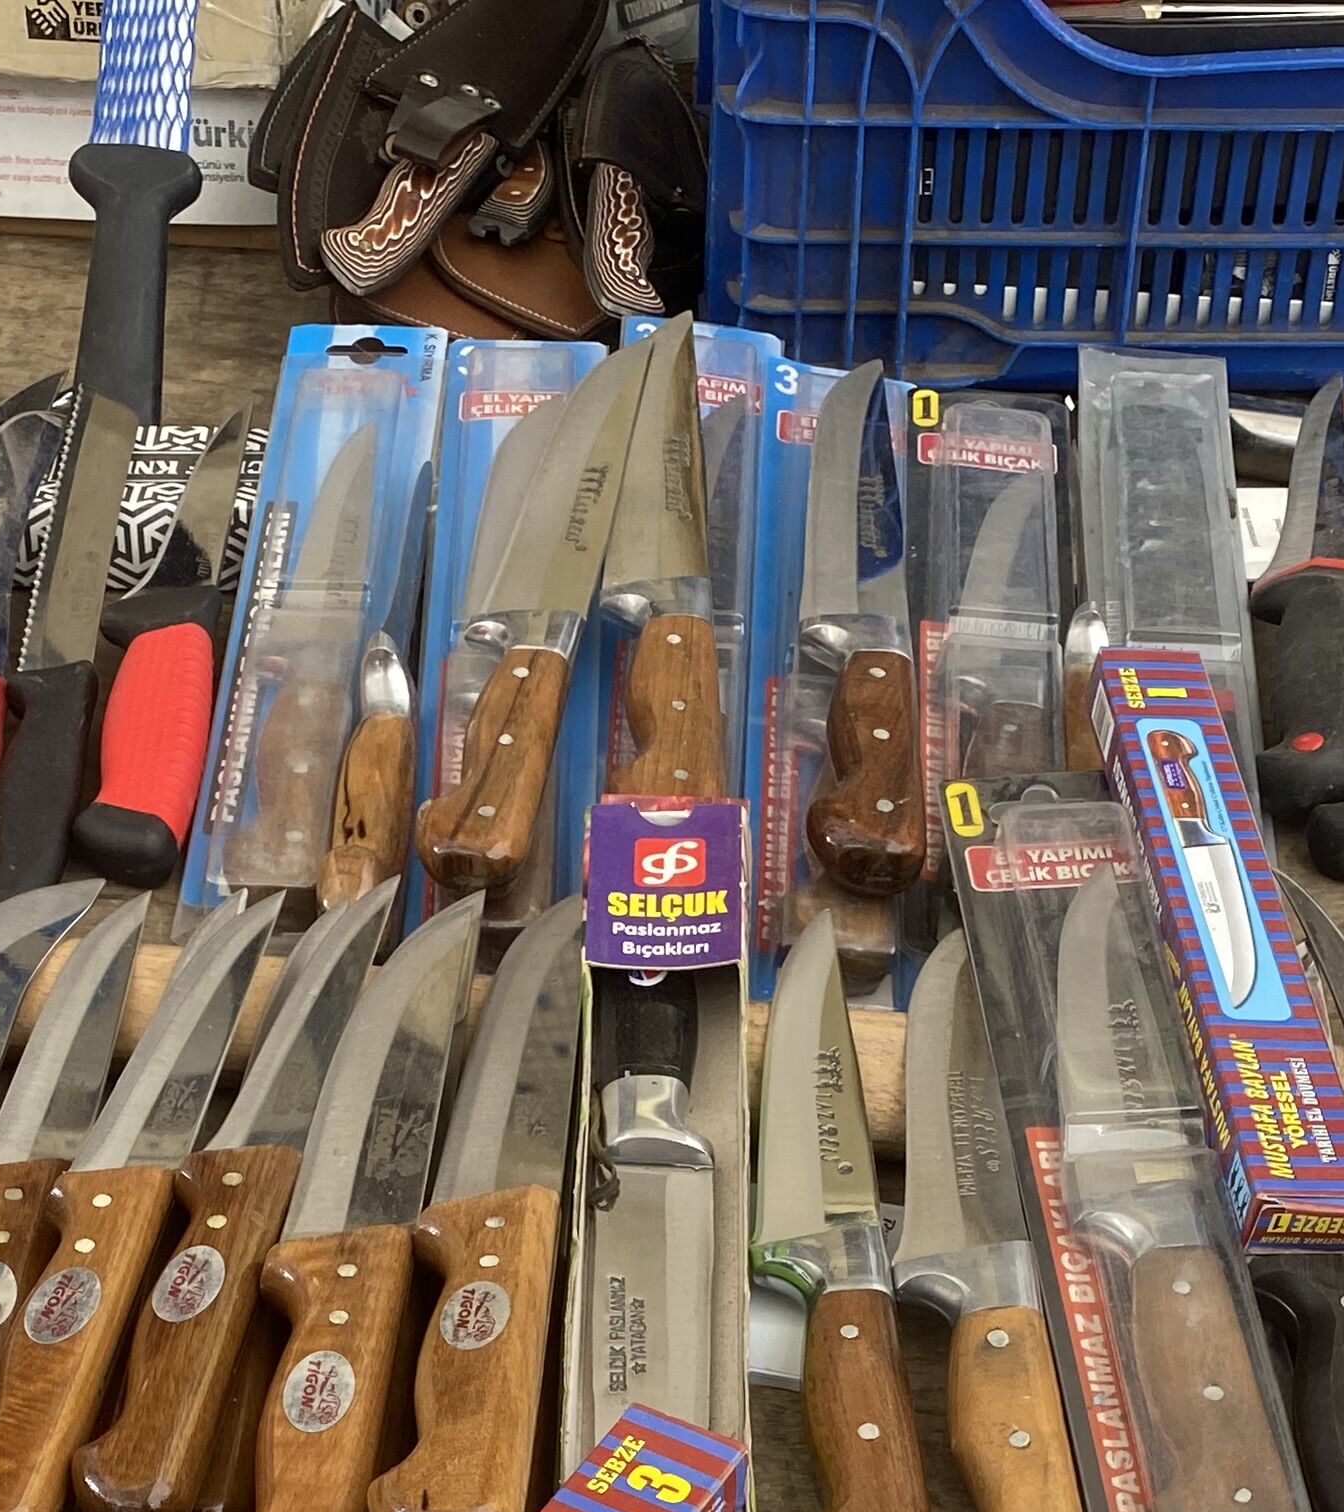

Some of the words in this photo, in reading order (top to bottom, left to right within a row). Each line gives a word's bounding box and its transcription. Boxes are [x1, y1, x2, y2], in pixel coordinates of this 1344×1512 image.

[774, 364, 801, 395] 3
[1057, 860, 1131, 884] BIÇK
[607, 890, 729, 922] SELÇUK
[612, 922, 722, 938] Paslanmaz
[622, 941, 710, 959] Bıçakları
[1230, 1038, 1271, 1101] BAYLAN
[1270, 1070, 1308, 1150] YÖRESEL
[1305, 1106, 1325, 1123] EL
[1250, 1103, 1295, 1180] MUSTAFA
[1306, 1123, 1338, 1163] TARİHİ
[585, 1433, 646, 1495] SEBZE
[626, 1464, 693, 1506] 3
